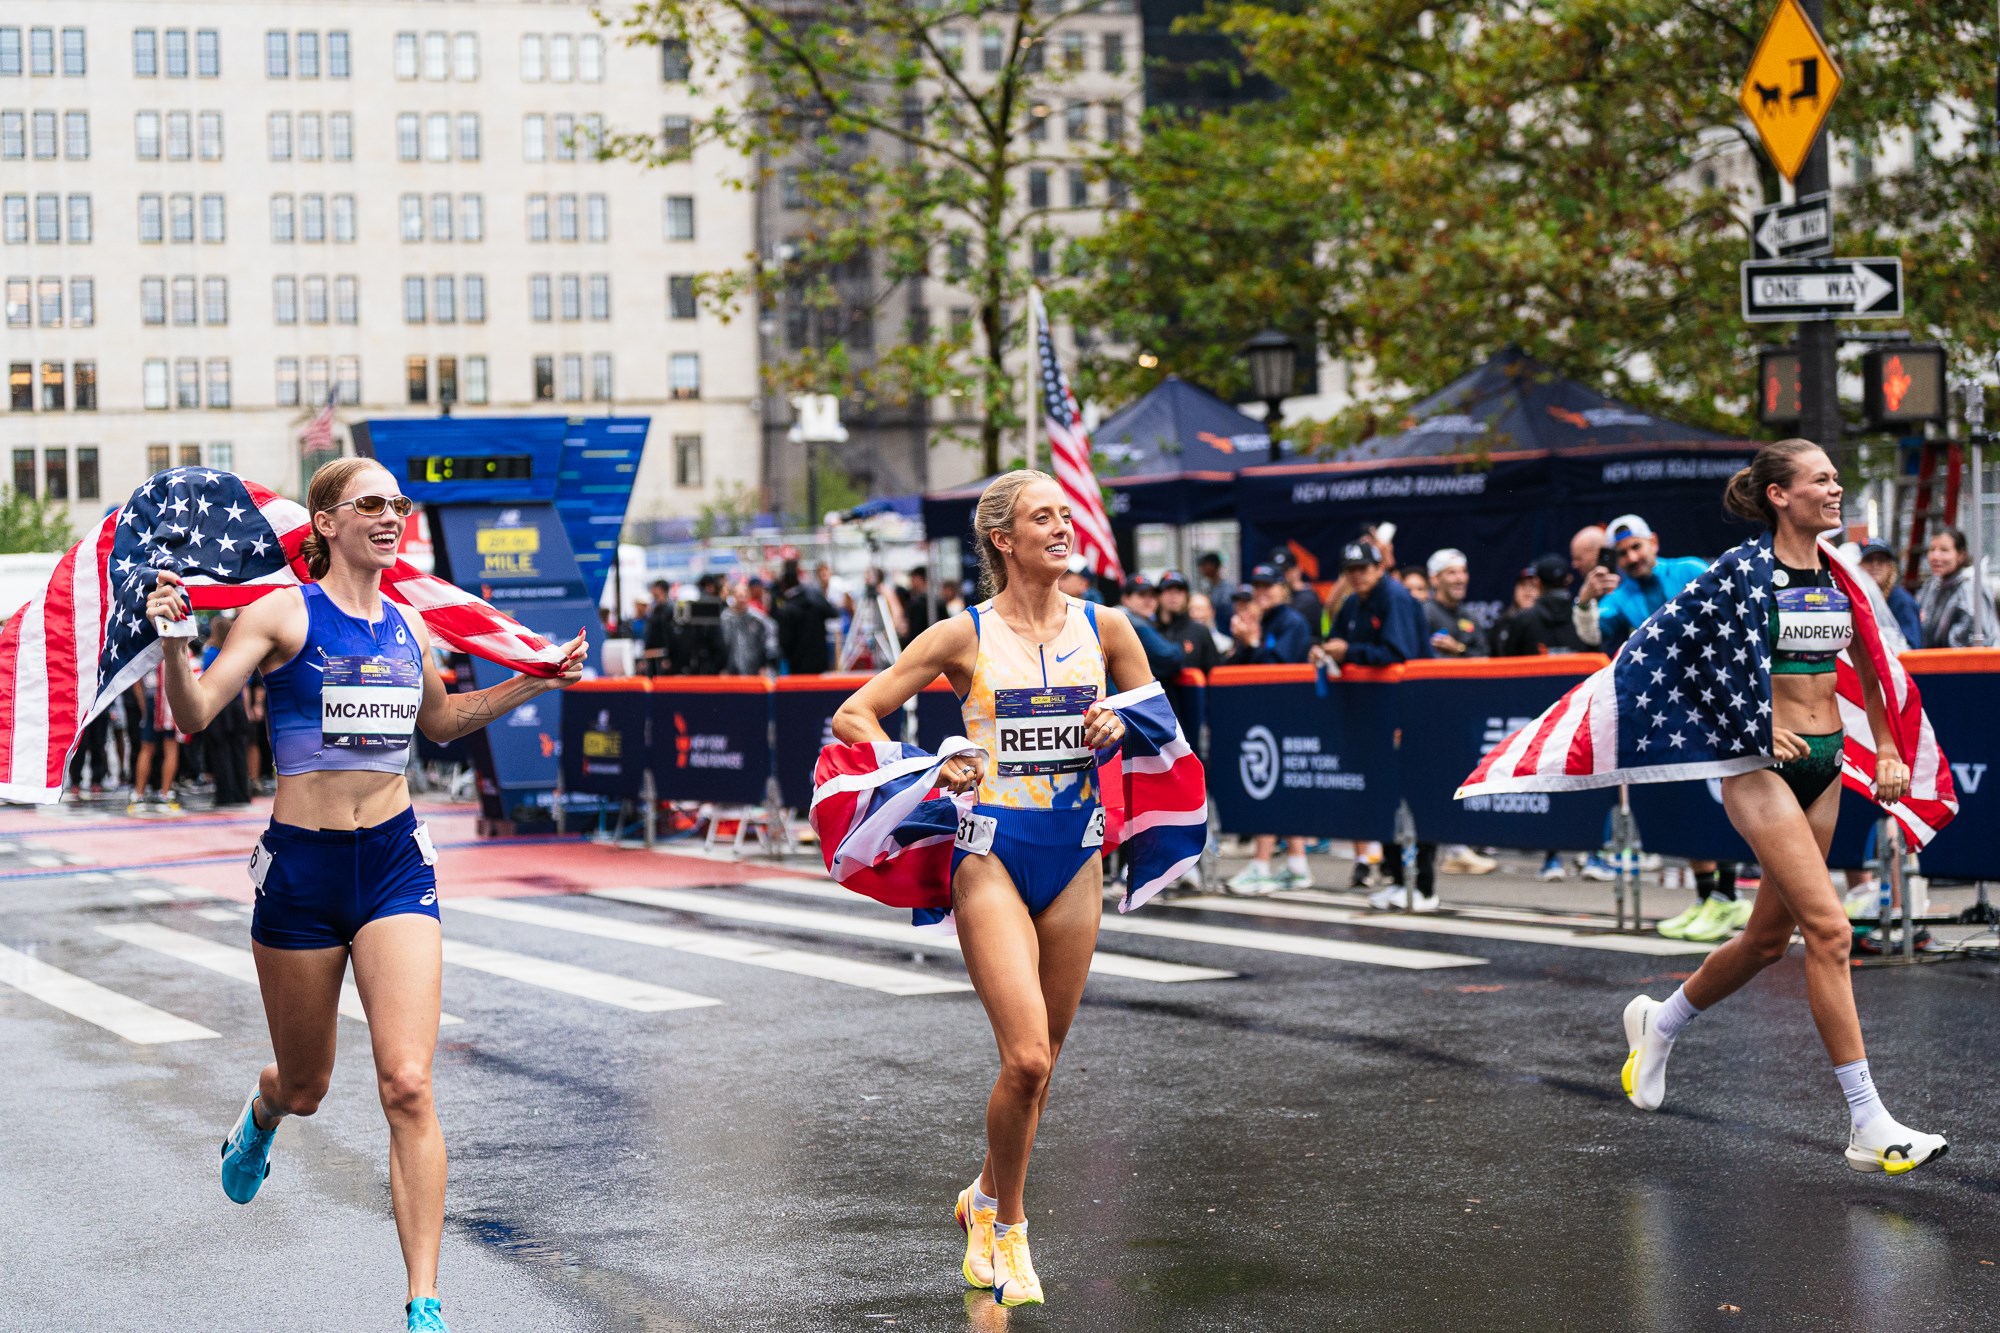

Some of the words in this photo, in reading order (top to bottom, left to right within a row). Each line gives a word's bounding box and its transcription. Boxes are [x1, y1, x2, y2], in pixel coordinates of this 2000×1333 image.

[1801, 214, 1821, 237] WAY
[1762, 277, 1804, 304] ONE
[1826, 276, 1870, 303] WAY
[1602, 463, 1630, 483] NEW
[1632, 460, 1664, 481] YORK
[1292, 482, 1327, 503] NEW
[1329, 478, 1367, 500] YORK
[1370, 475, 1413, 497] ROAD
[1416, 472, 1487, 496] RUNNERS
[485, 553, 532, 571] MILE
[1783, 624, 1852, 639] ANDREWS
[325, 702, 417, 719] MCARTHUR
[1282, 736, 1321, 753] RISING
[1282, 755, 1308, 770] NEW
[1310, 754, 1340, 771] YORK
[1283, 772, 1313, 788] ROAD
[1315, 773, 1365, 791] RUNNERS
[957, 817, 975, 843] 31
[1096, 813, 1106, 837] 3
